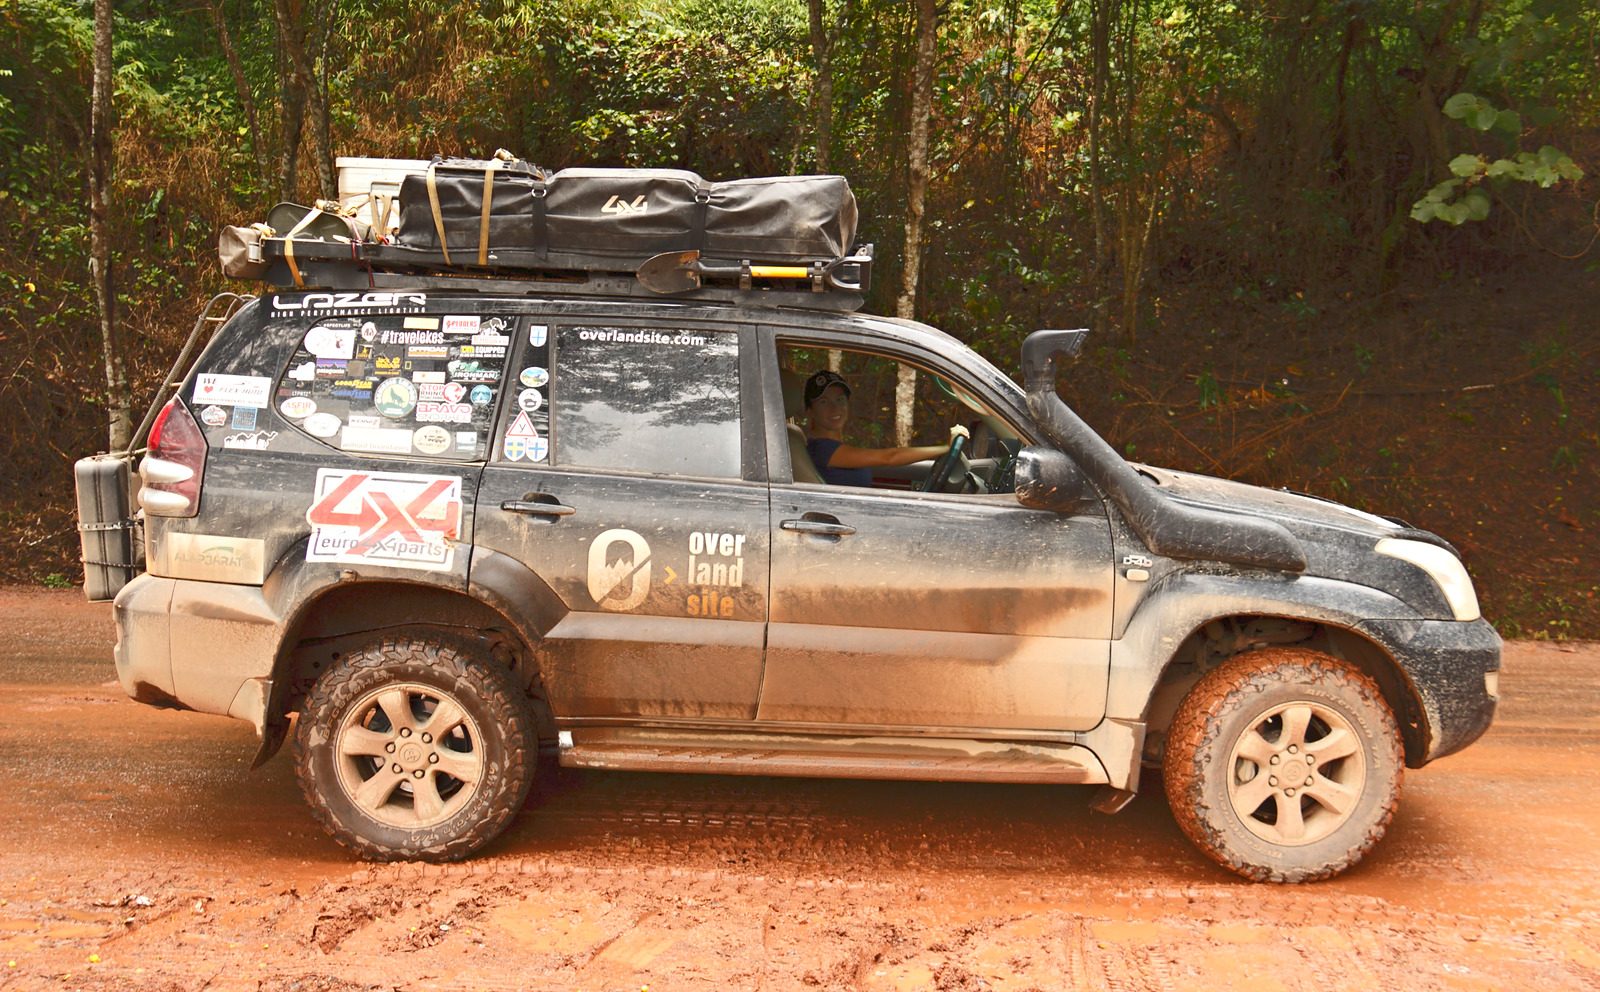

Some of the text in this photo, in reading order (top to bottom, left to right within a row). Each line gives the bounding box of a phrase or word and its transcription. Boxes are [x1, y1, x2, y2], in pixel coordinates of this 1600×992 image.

[272, 292, 427, 310] LAZER
[300, 307, 372, 317] PERFORMANCE
[579, 329, 704, 346] overlandsite.com
[418, 403, 471, 413] BRAVO
[688, 531, 746, 557] over
[687, 554, 744, 588] land
[686, 589, 735, 617] site
